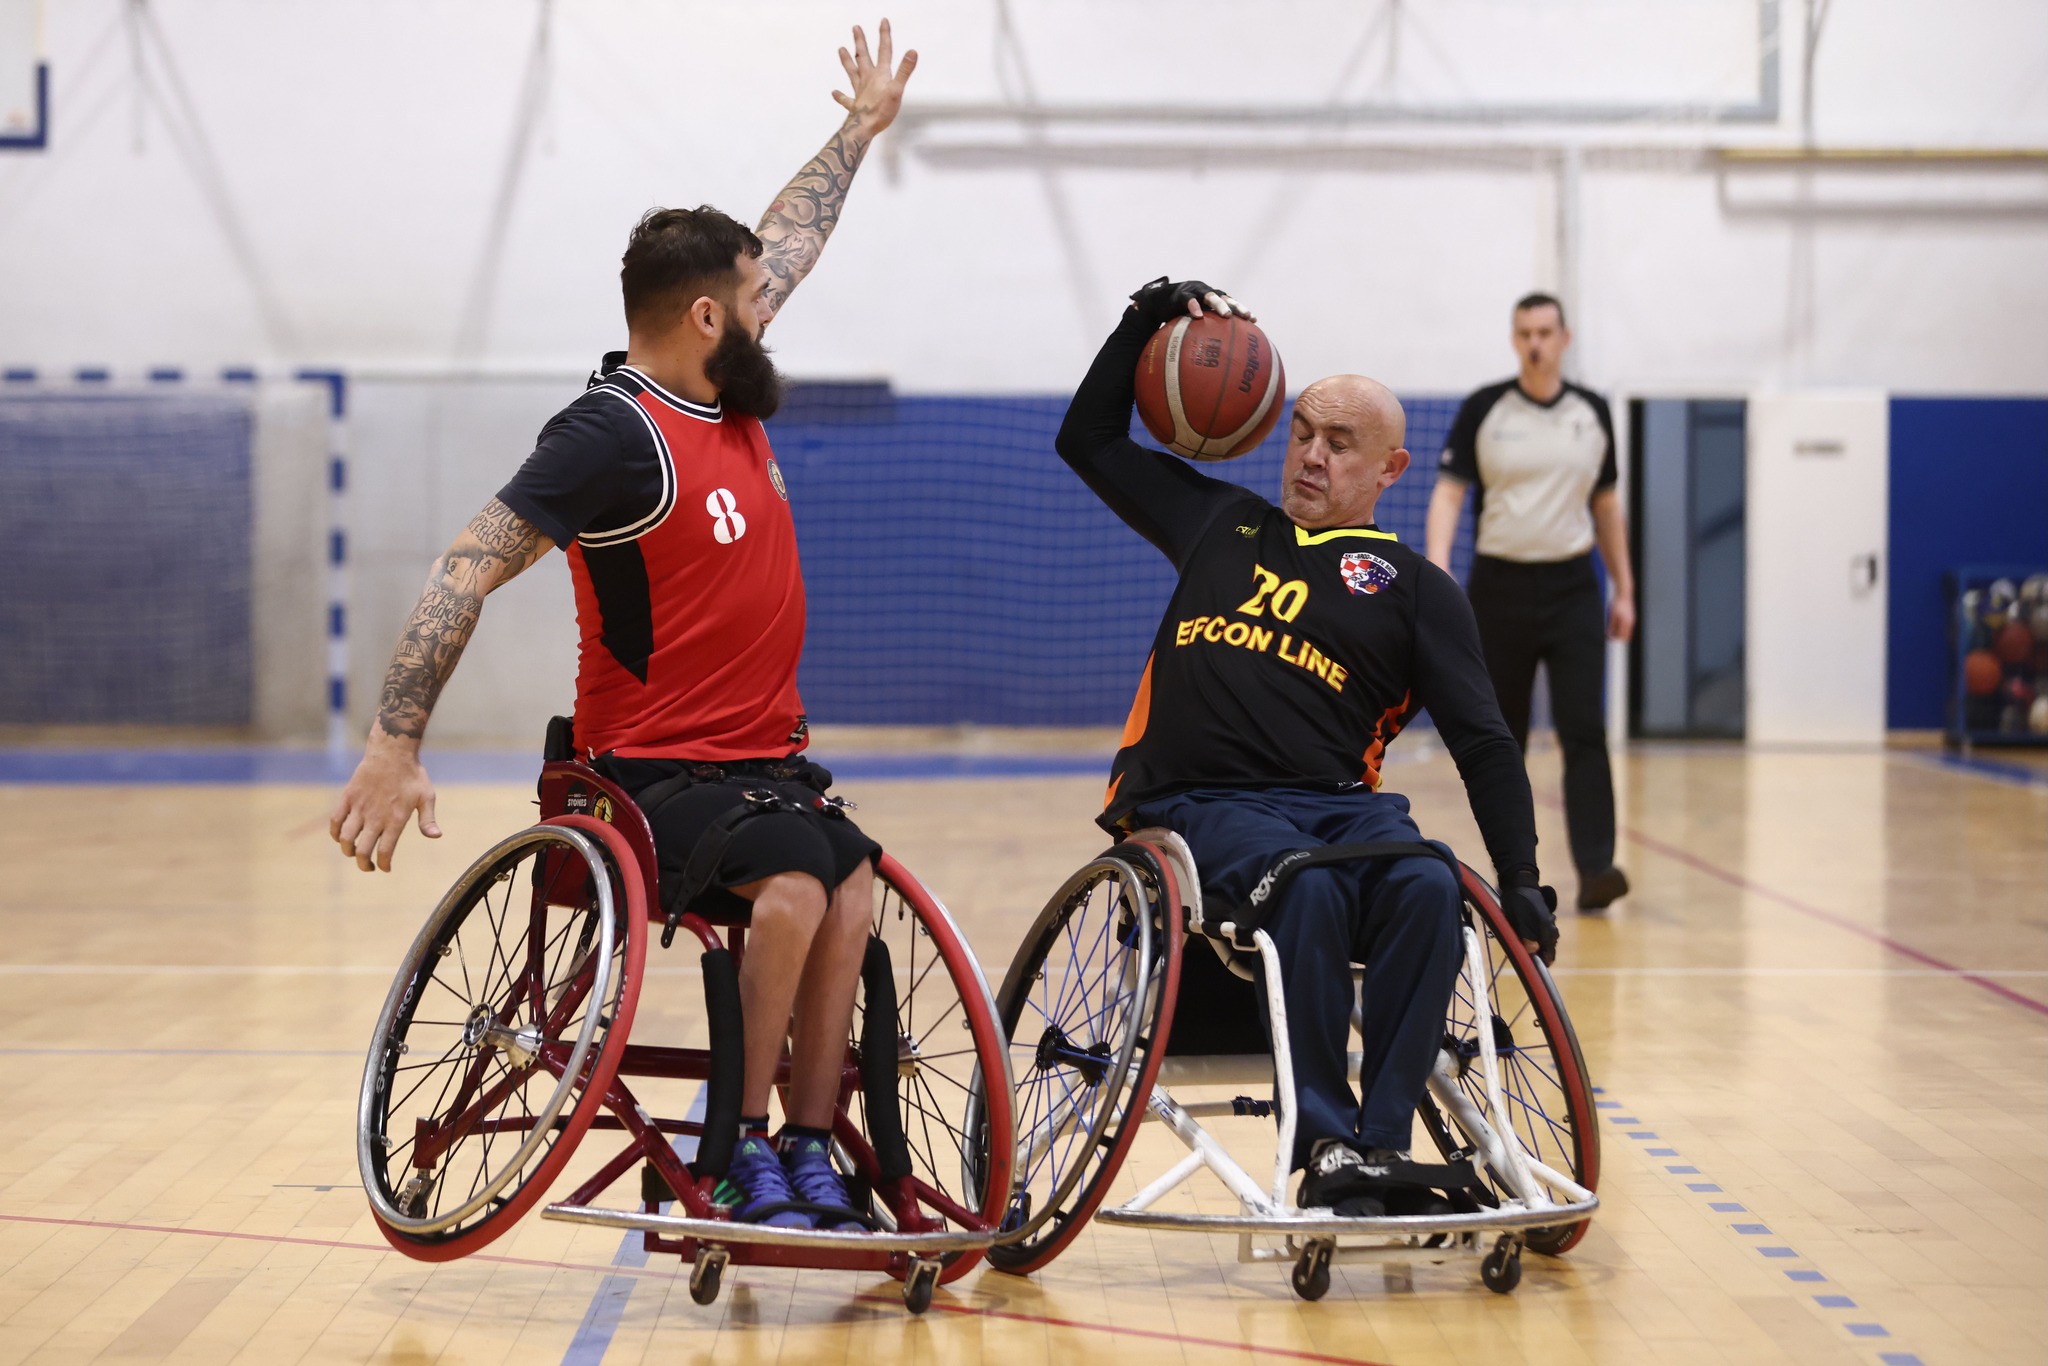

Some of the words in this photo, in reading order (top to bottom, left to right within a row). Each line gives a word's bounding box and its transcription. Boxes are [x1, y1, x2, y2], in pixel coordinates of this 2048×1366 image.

[706, 488, 746, 545] 8
[1236, 563, 1309, 624] 20
[1175, 615, 1274, 653] EFCON
[1277, 634, 1349, 694] LINE
